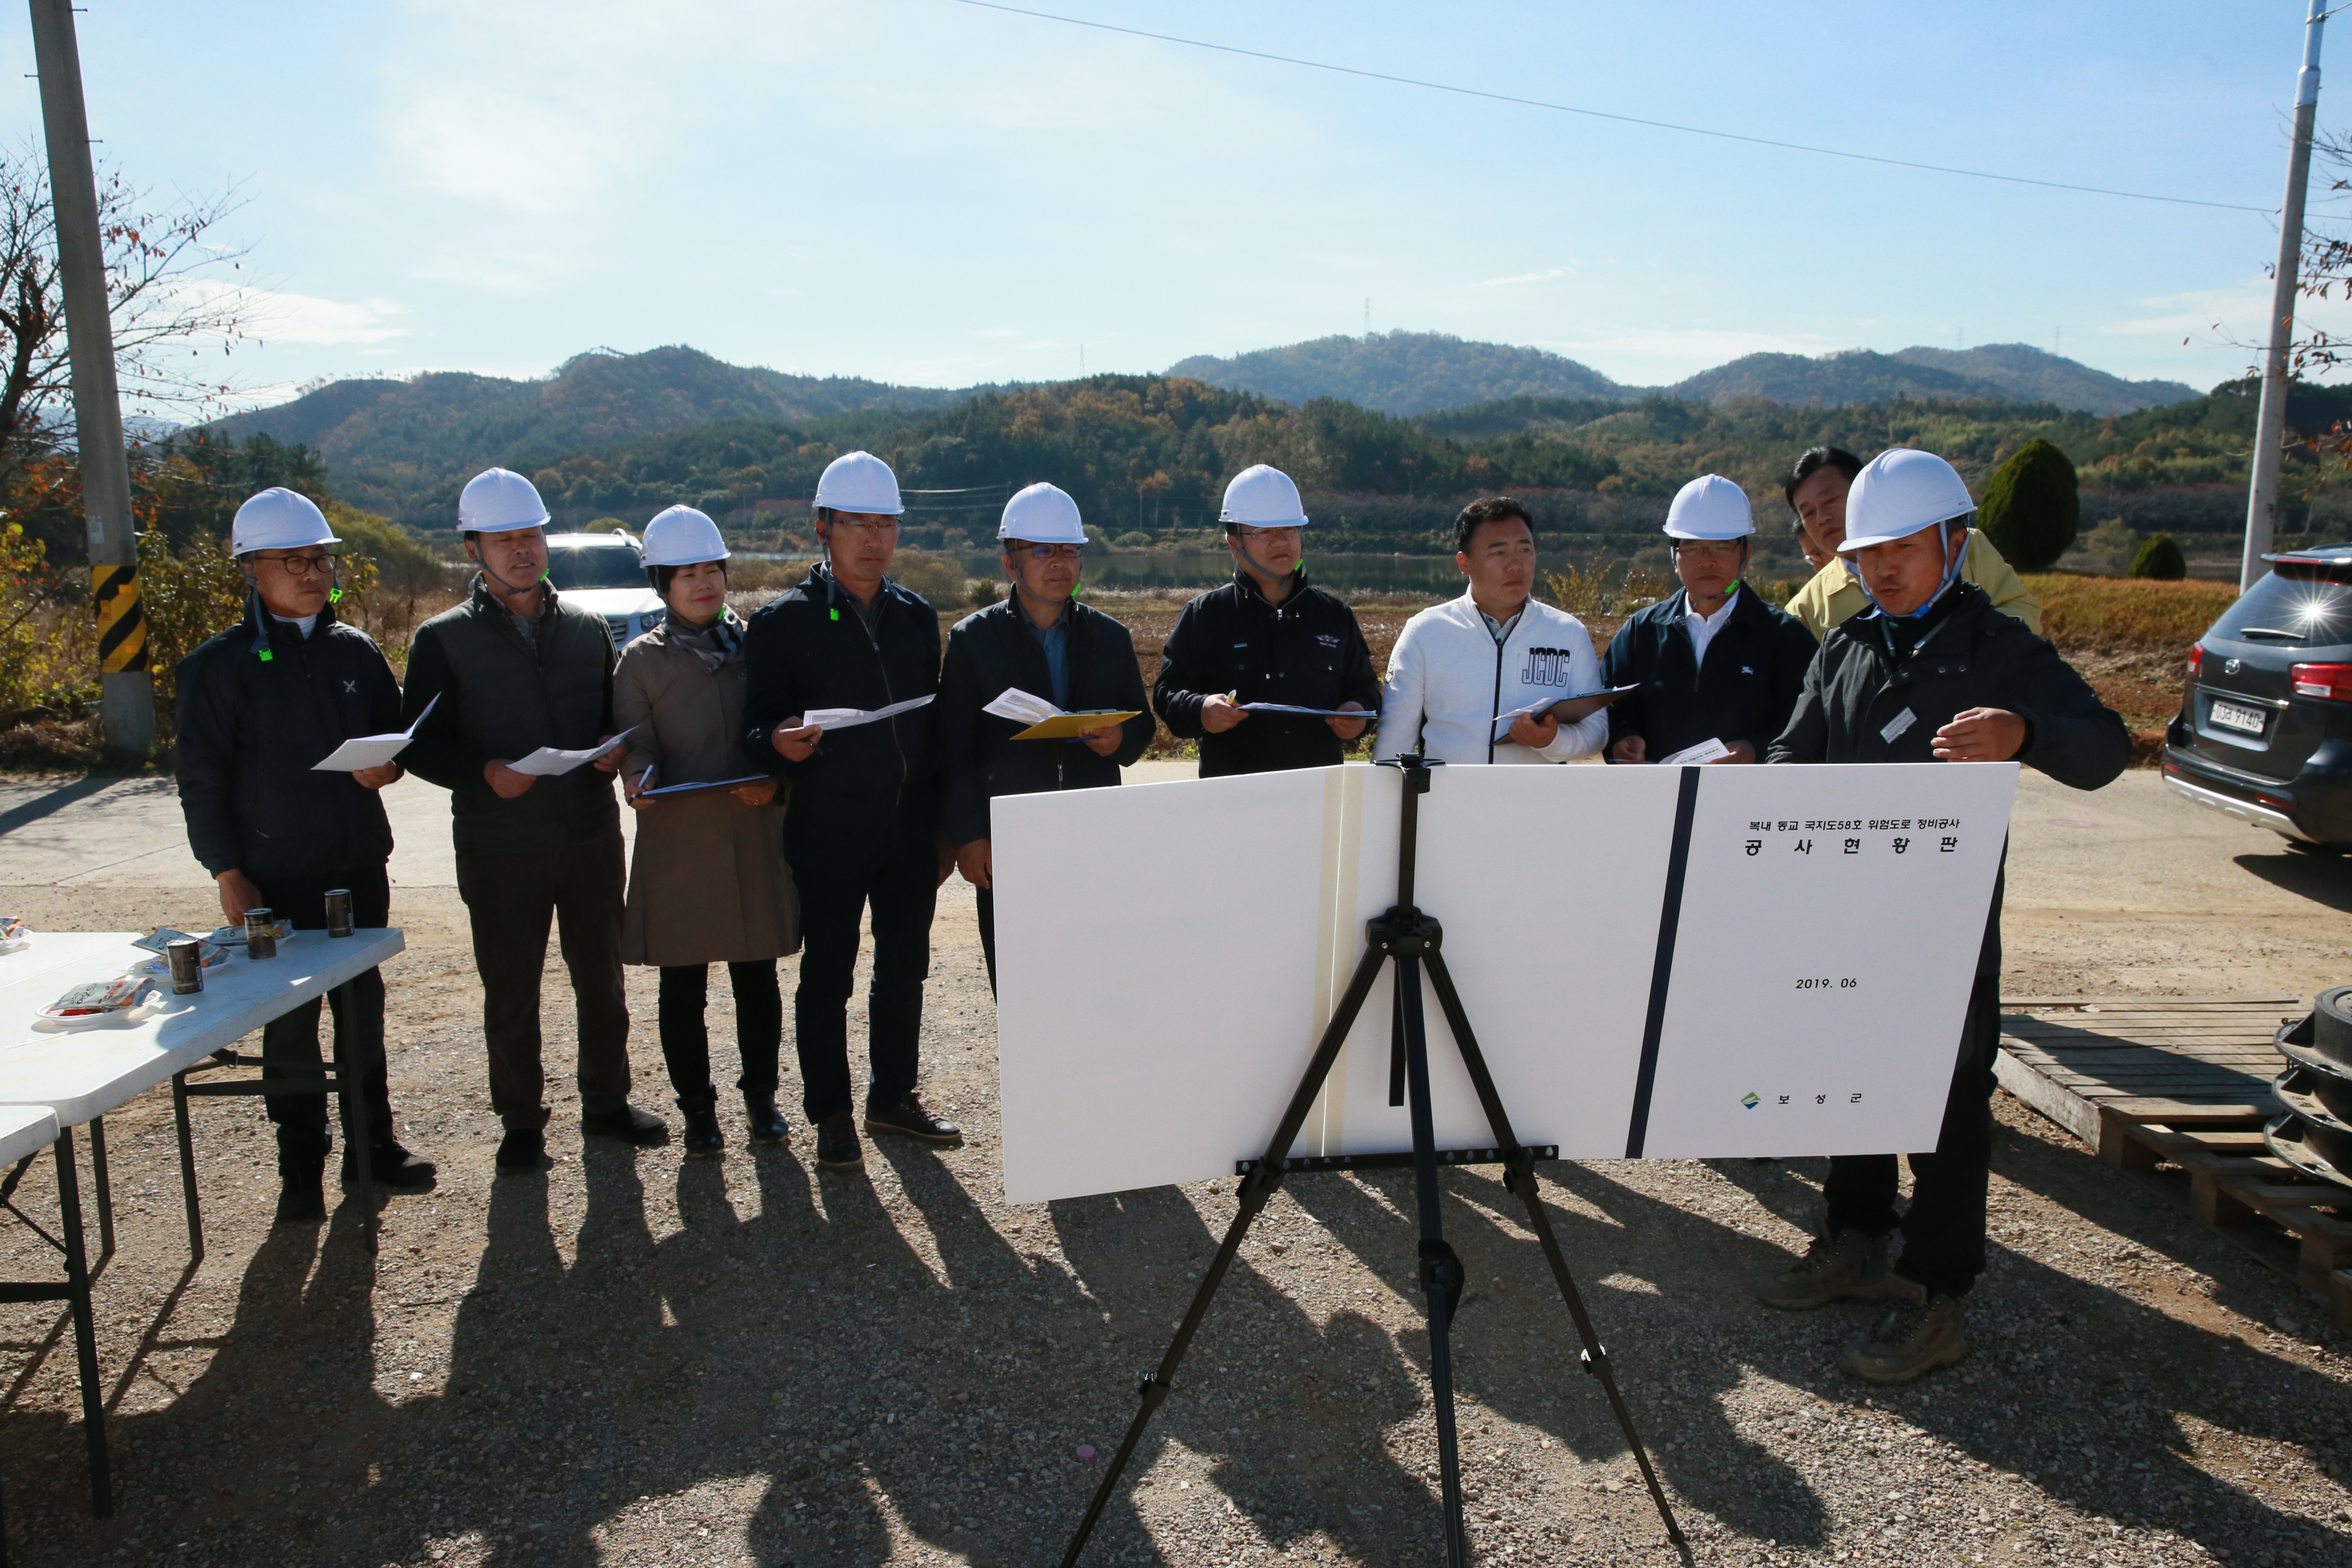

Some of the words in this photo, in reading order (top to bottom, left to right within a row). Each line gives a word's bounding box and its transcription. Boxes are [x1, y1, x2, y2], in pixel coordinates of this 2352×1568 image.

[1522, 647, 1570, 687] JCDC
[1750, 822, 1771, 831] 복내
[1778, 821, 1798, 831] 동교
[1805, 820, 1862, 830] 국지도58호
[1868, 820, 1911, 829] 위험도로
[1917, 819, 1960, 829] 정비공사
[1796, 979, 1832, 988] 2019.
[1841, 979, 1856, 988] 06
